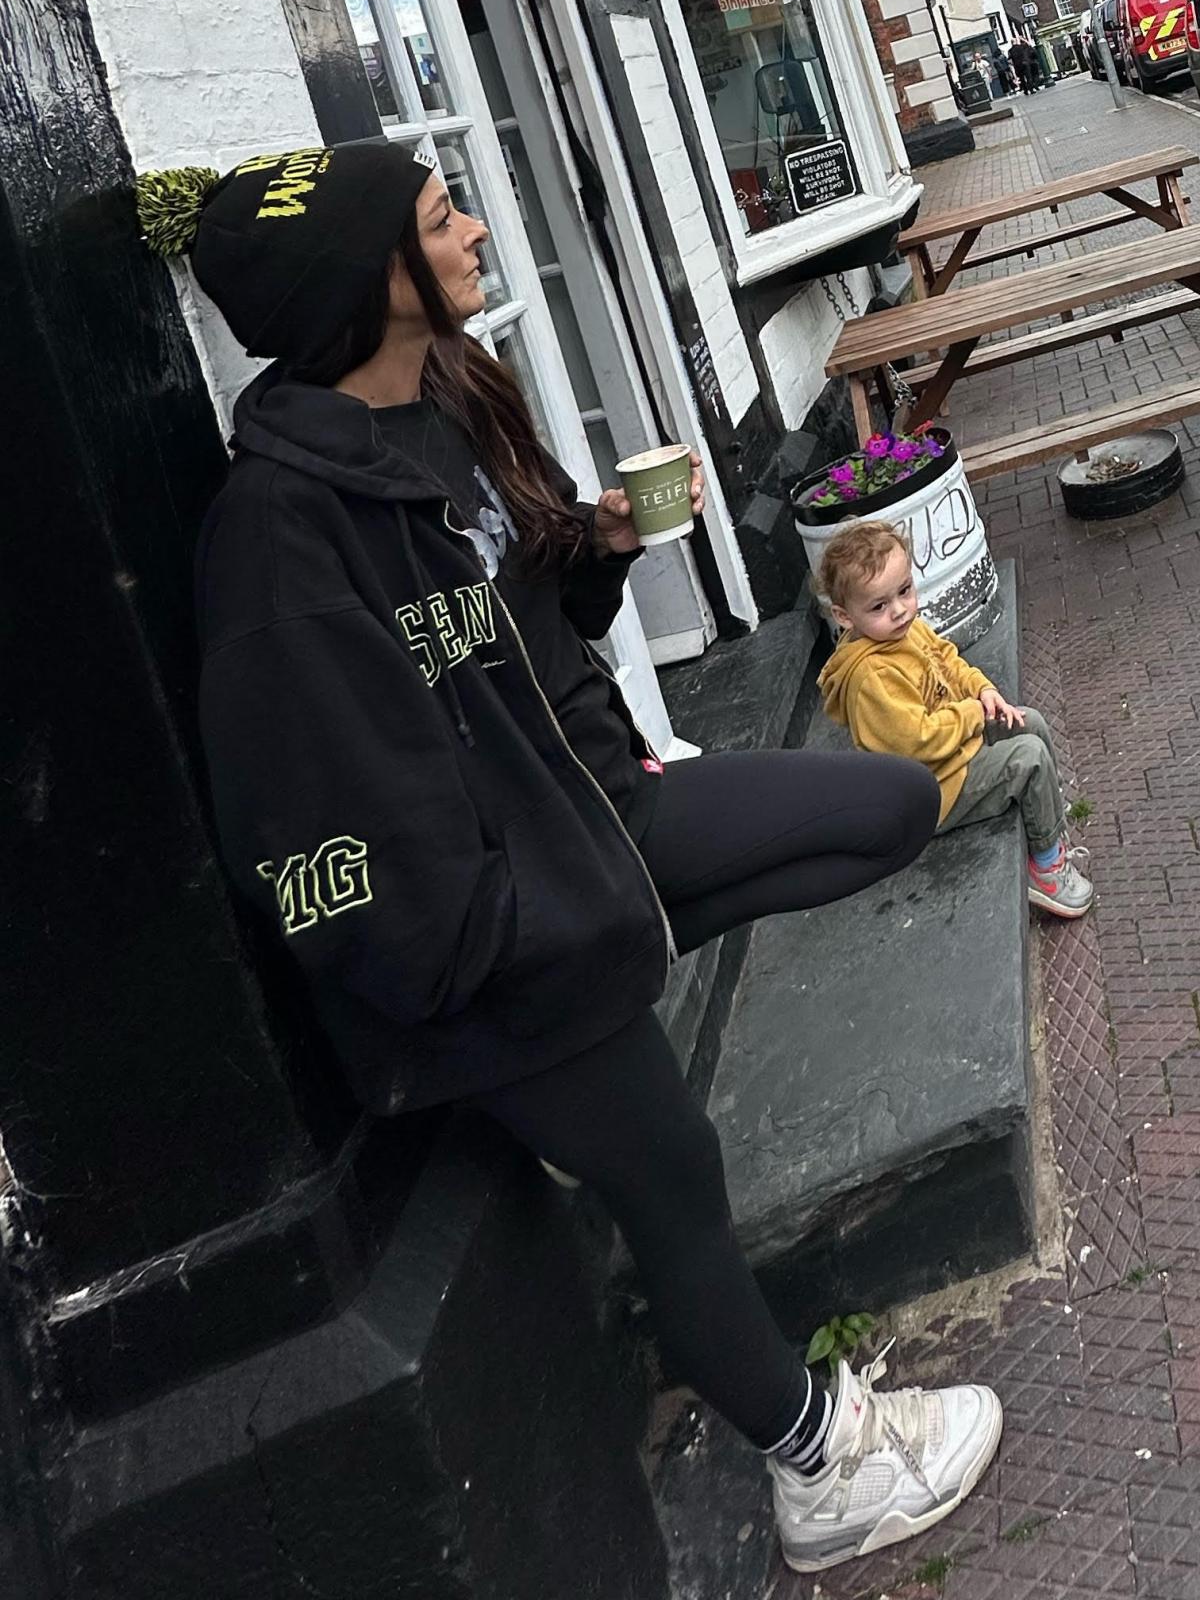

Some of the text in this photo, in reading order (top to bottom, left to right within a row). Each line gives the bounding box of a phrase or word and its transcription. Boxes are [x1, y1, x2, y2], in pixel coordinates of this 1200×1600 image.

[788, 146, 844, 169] NO TRESPASSING
[801, 159, 837, 176] VIOLATORS
[799, 174, 815, 184] WILL
[815, 171, 825, 180] BE
[805, 174, 840, 191] SURVIVORS
[803, 189, 820, 199] WILL
[640, 481, 688, 507] TEIFI
